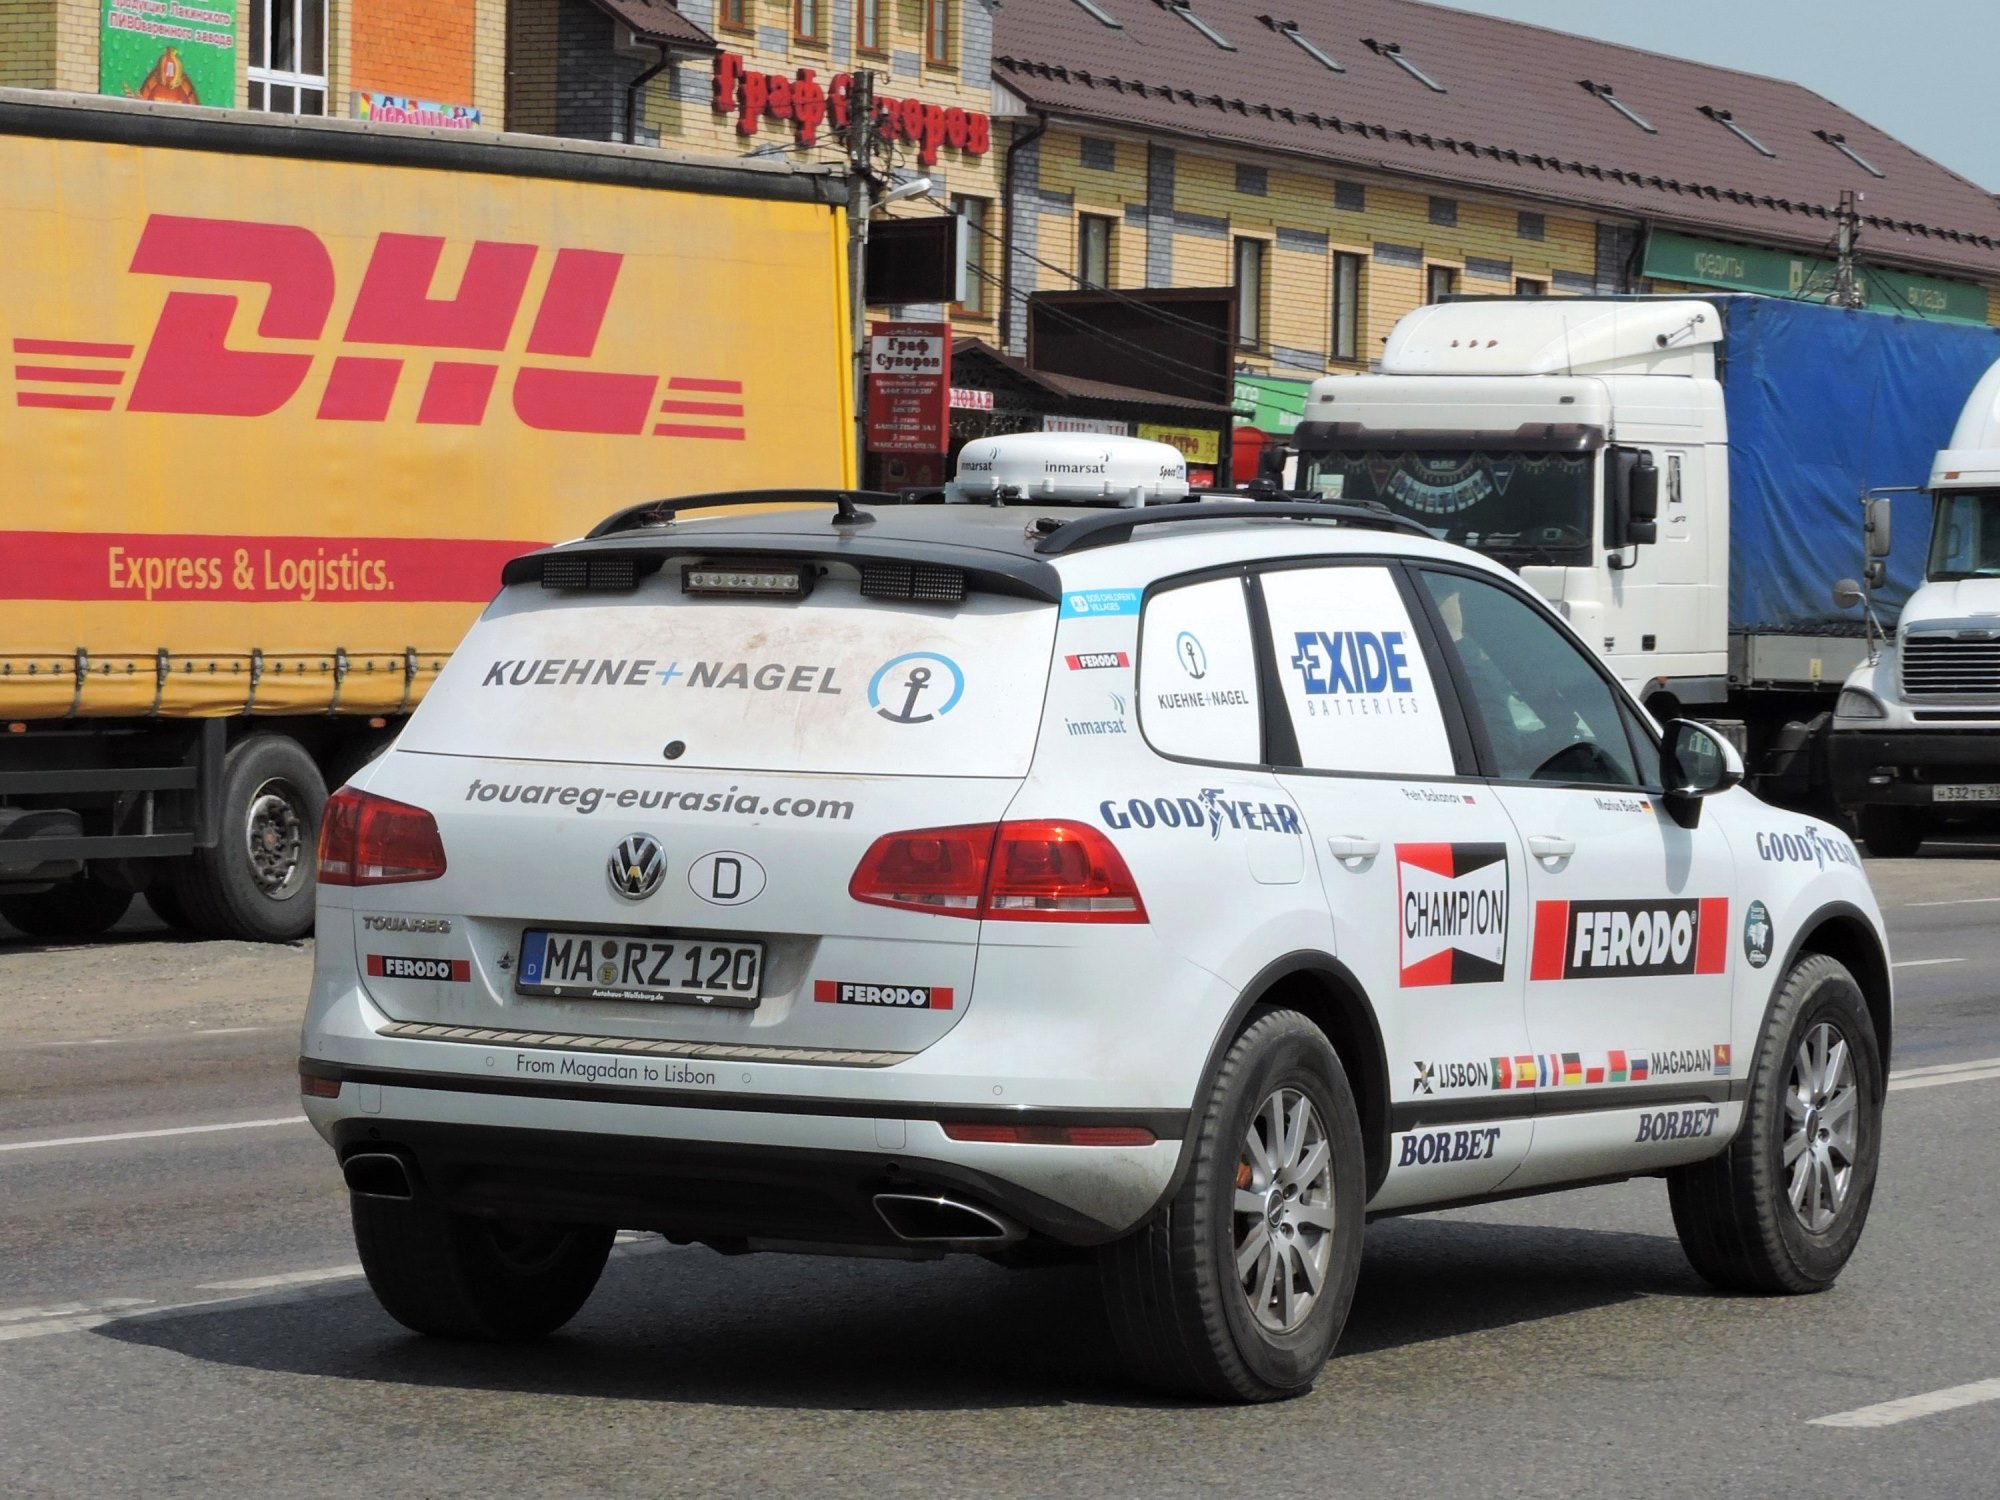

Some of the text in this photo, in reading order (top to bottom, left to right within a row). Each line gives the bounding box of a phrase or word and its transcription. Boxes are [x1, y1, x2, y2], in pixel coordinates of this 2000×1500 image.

[713, 52, 990, 166] Граф Своров
[126, 213, 659, 436] DHL
[876, 353, 940, 371] Суворов
[887, 338, 930, 356] Граф
[1045, 461, 1106, 474] inmarsat
[109, 546, 395, 601] Express & Logistics.
[1079, 654, 1118, 668] FERODO
[1291, 631, 1413, 695] EXIDE
[1307, 697, 1418, 716] BATTERIES
[1065, 717, 1126, 736] inmarsat
[465, 779, 855, 821] touareg-eurasia.com
[712, 857, 742, 899] D
[363, 916, 452, 933] TOUAREG
[1405, 889, 1504, 939] CHAMPION
[1572, 910, 1693, 968] FERODO
[386, 959, 450, 978] FERODO
[842, 985, 928, 1006] FERODO
[516, 1054, 715, 1085] From Magadan to Lisbon
[1439, 1049, 1711, 1089] LISBON MAGADAN
[1635, 1107, 1719, 1143] BORBET
[1398, 1127, 1500, 1167] BORBET
